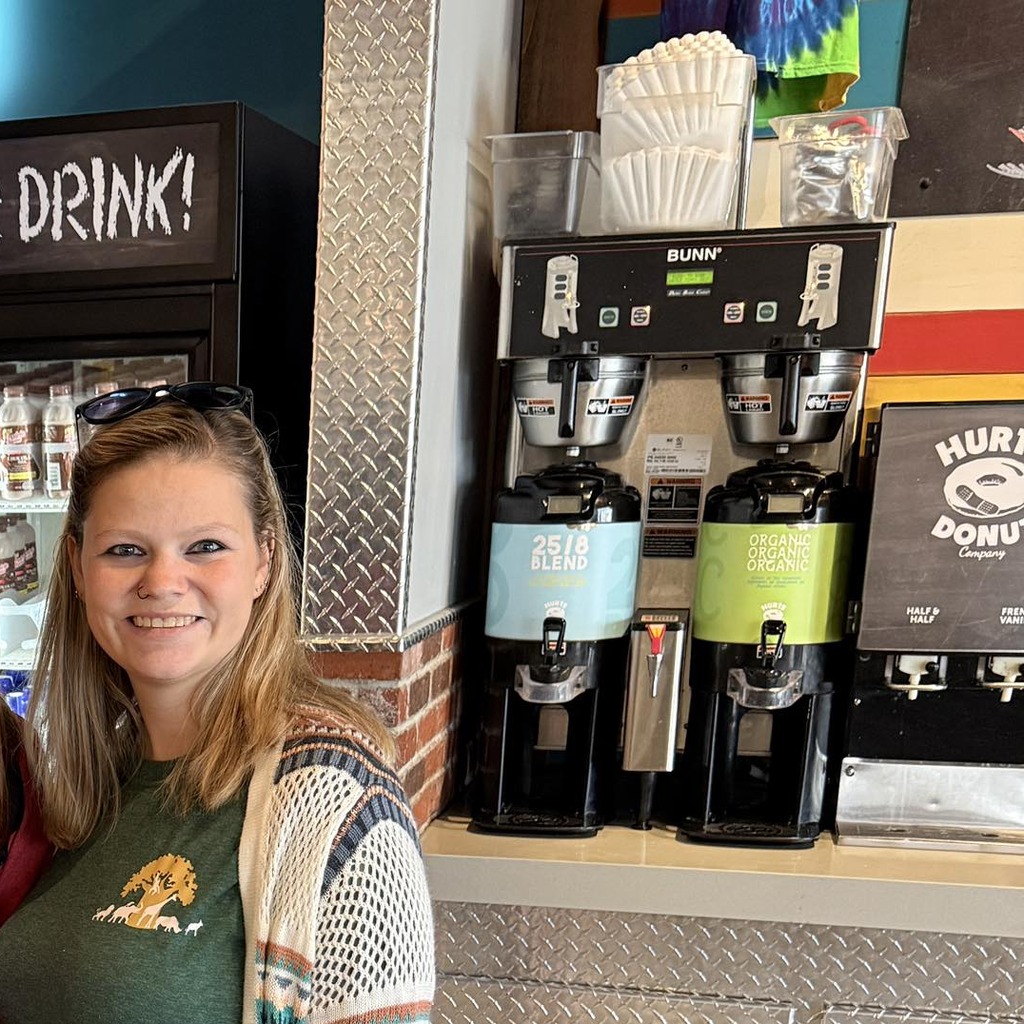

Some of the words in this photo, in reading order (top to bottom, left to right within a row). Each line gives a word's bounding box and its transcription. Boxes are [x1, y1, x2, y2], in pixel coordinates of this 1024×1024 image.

[17, 146, 195, 242] DRINK!
[930, 515, 1024, 546] DONU
[532, 535, 589, 556] 25/8
[750, 534, 811, 547] ORGANIC
[748, 547, 810, 560] ORGANIC
[958, 546, 1006, 560] Company
[531, 555, 588, 570] BLEND
[747, 559, 808, 571] ORGANIC
[906, 607, 932, 615] HALF
[933, 606, 940, 615] &
[910, 615, 935, 623] HALF
